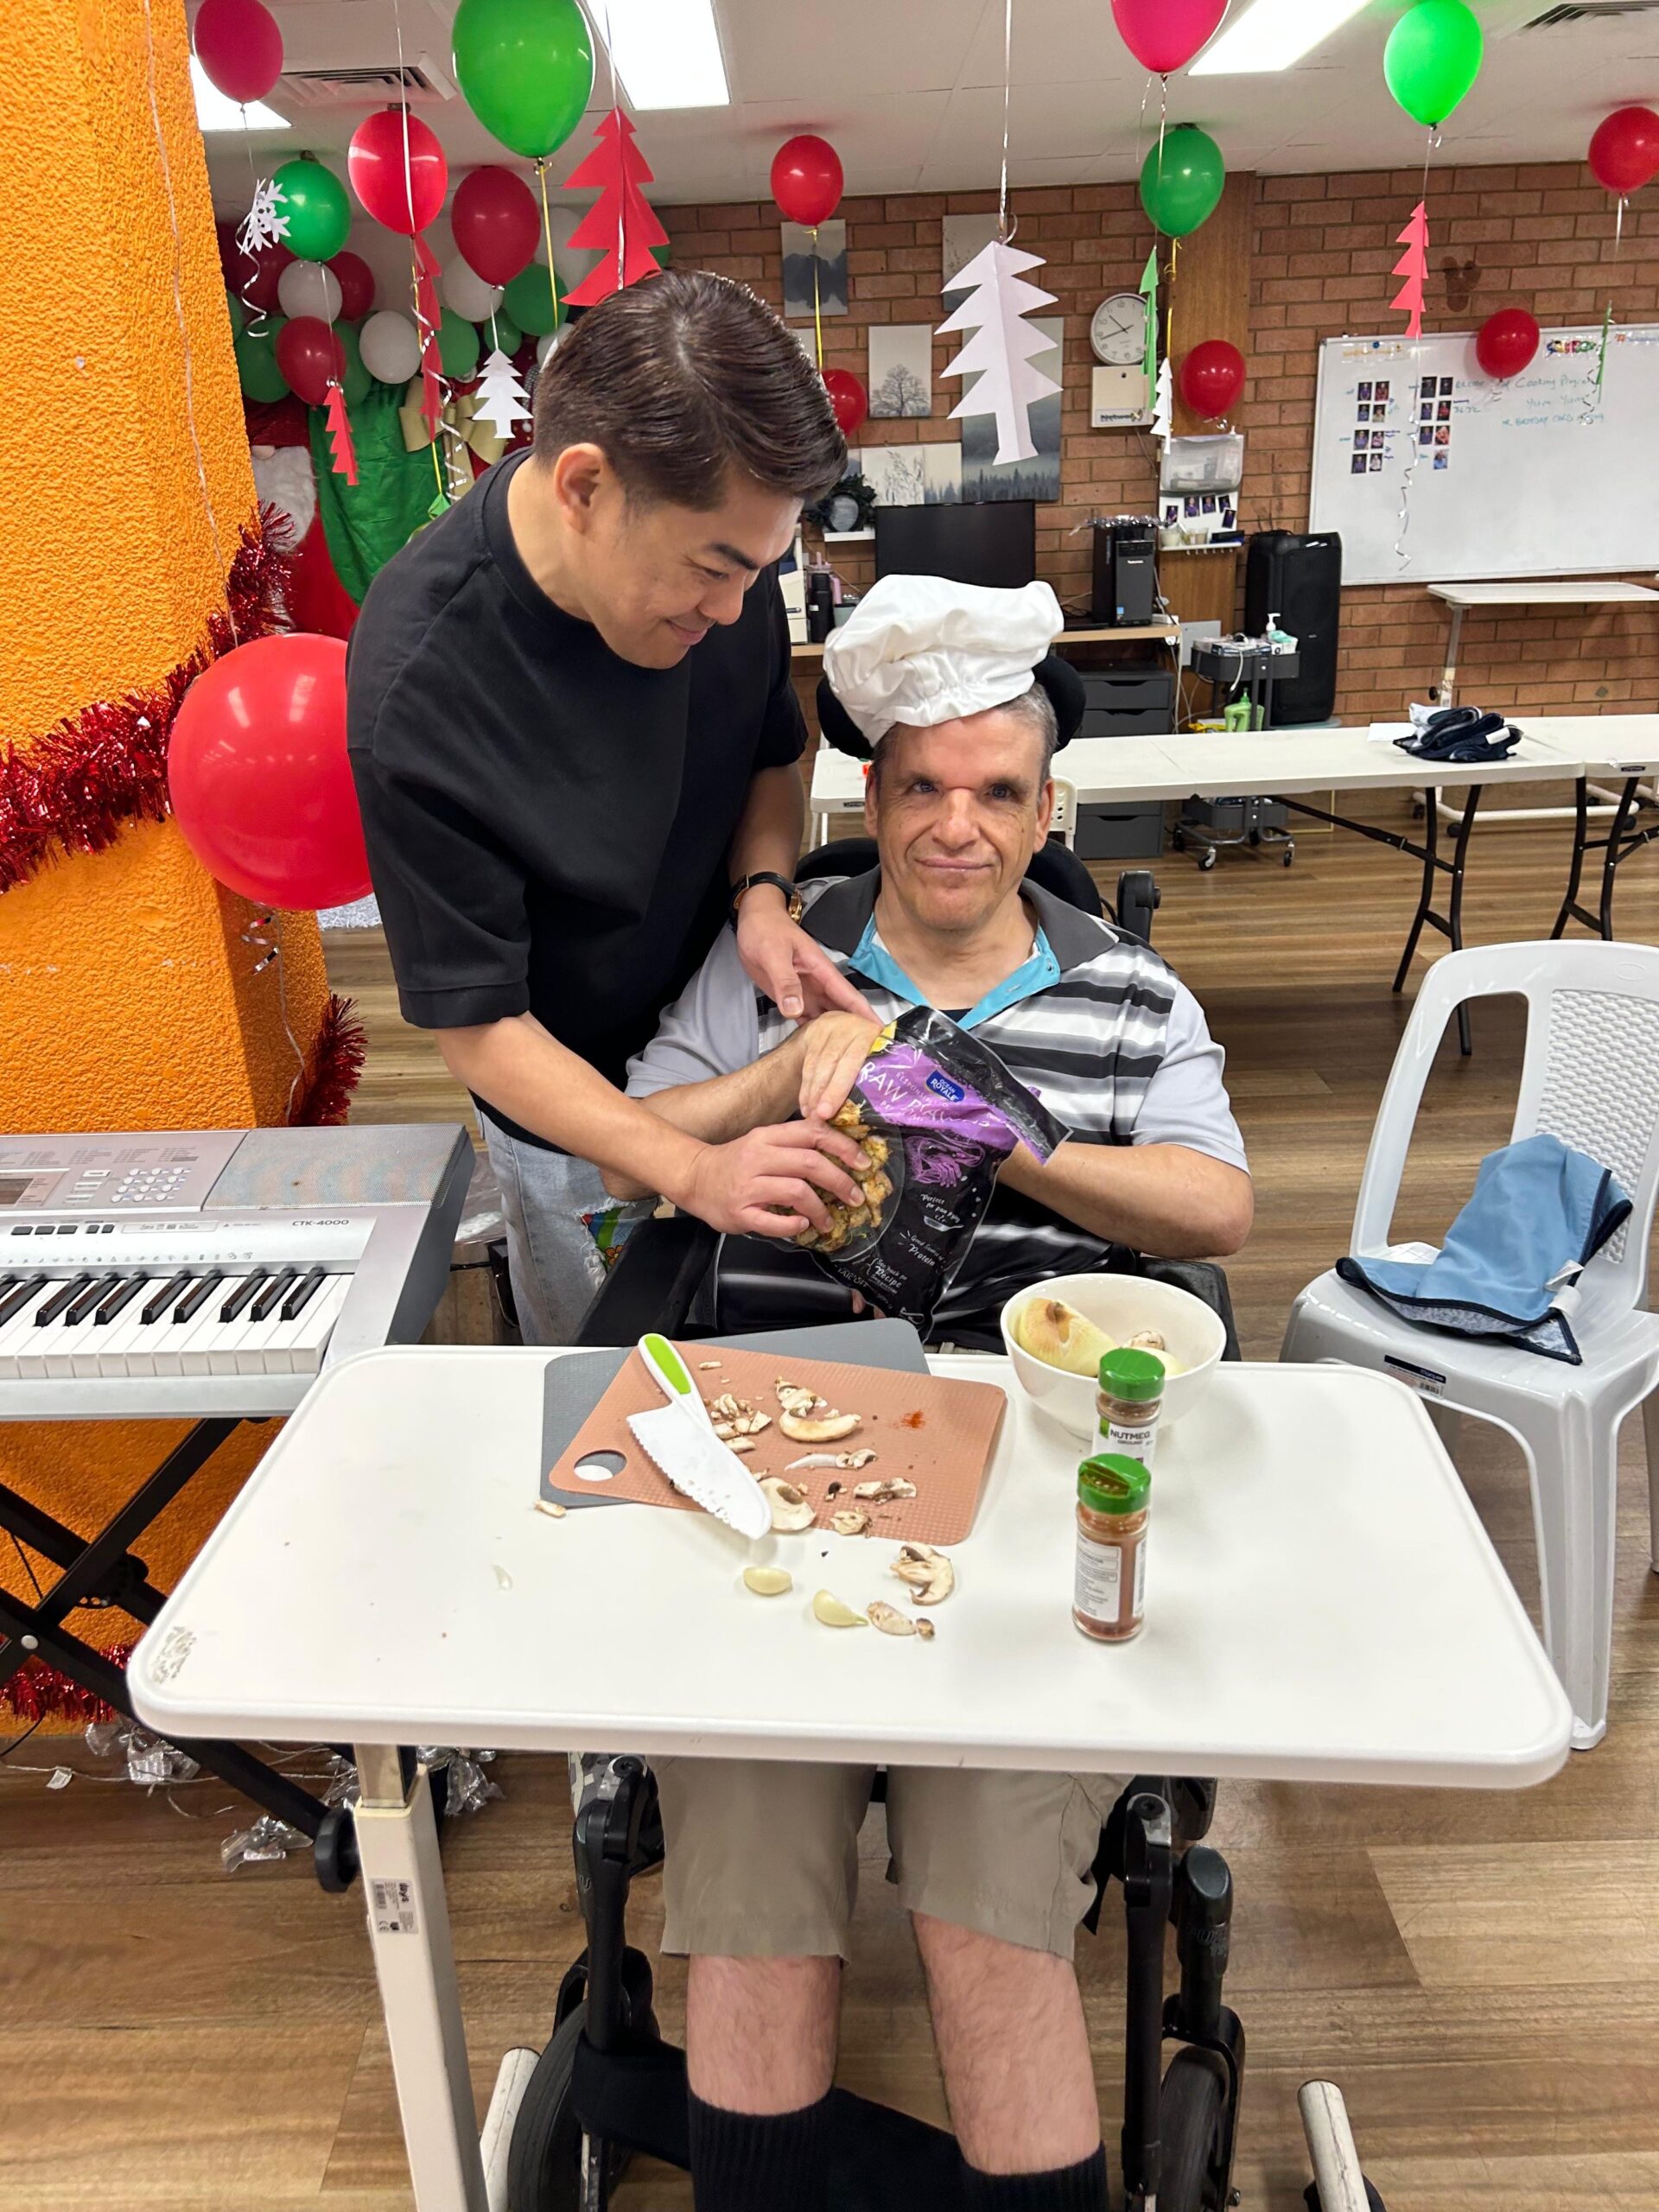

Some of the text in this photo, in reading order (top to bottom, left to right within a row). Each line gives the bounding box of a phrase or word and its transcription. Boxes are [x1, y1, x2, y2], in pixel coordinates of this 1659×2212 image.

[857, 1061, 908, 1103] RAW
[931, 1077, 958, 1102] ROYALE
[939, 1078, 956, 1094] OCEAN
[908, 1243, 936, 1267] Protein
[874, 1265, 903, 1287] Recipe
[1109, 1429, 1151, 1440] NUTMEG
